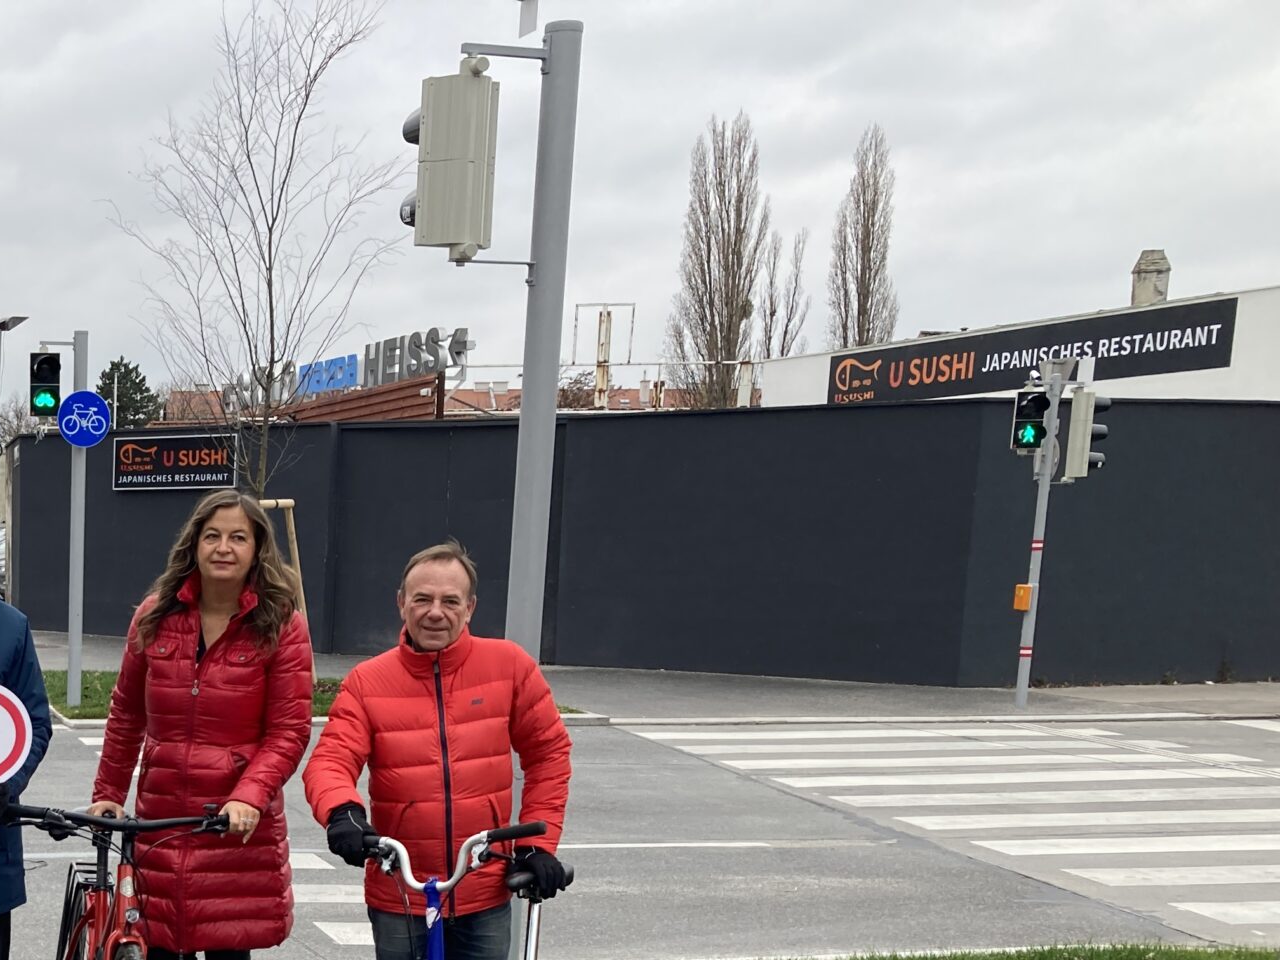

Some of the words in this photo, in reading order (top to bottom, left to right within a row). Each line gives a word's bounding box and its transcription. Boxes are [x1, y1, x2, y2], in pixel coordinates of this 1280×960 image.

[363, 327, 447, 388] HEISS
[889, 360, 905, 389] U
[908, 351, 976, 387] SUSHI
[981, 340, 1093, 373] JAPANISCHES
[1097, 323, 1222, 359] RESTAURANT
[162, 450, 174, 467] U
[178, 448, 228, 467] SUSHI
[118, 474, 172, 484] JAPANISCHES
[175, 473, 229, 482] RESTAURANT
